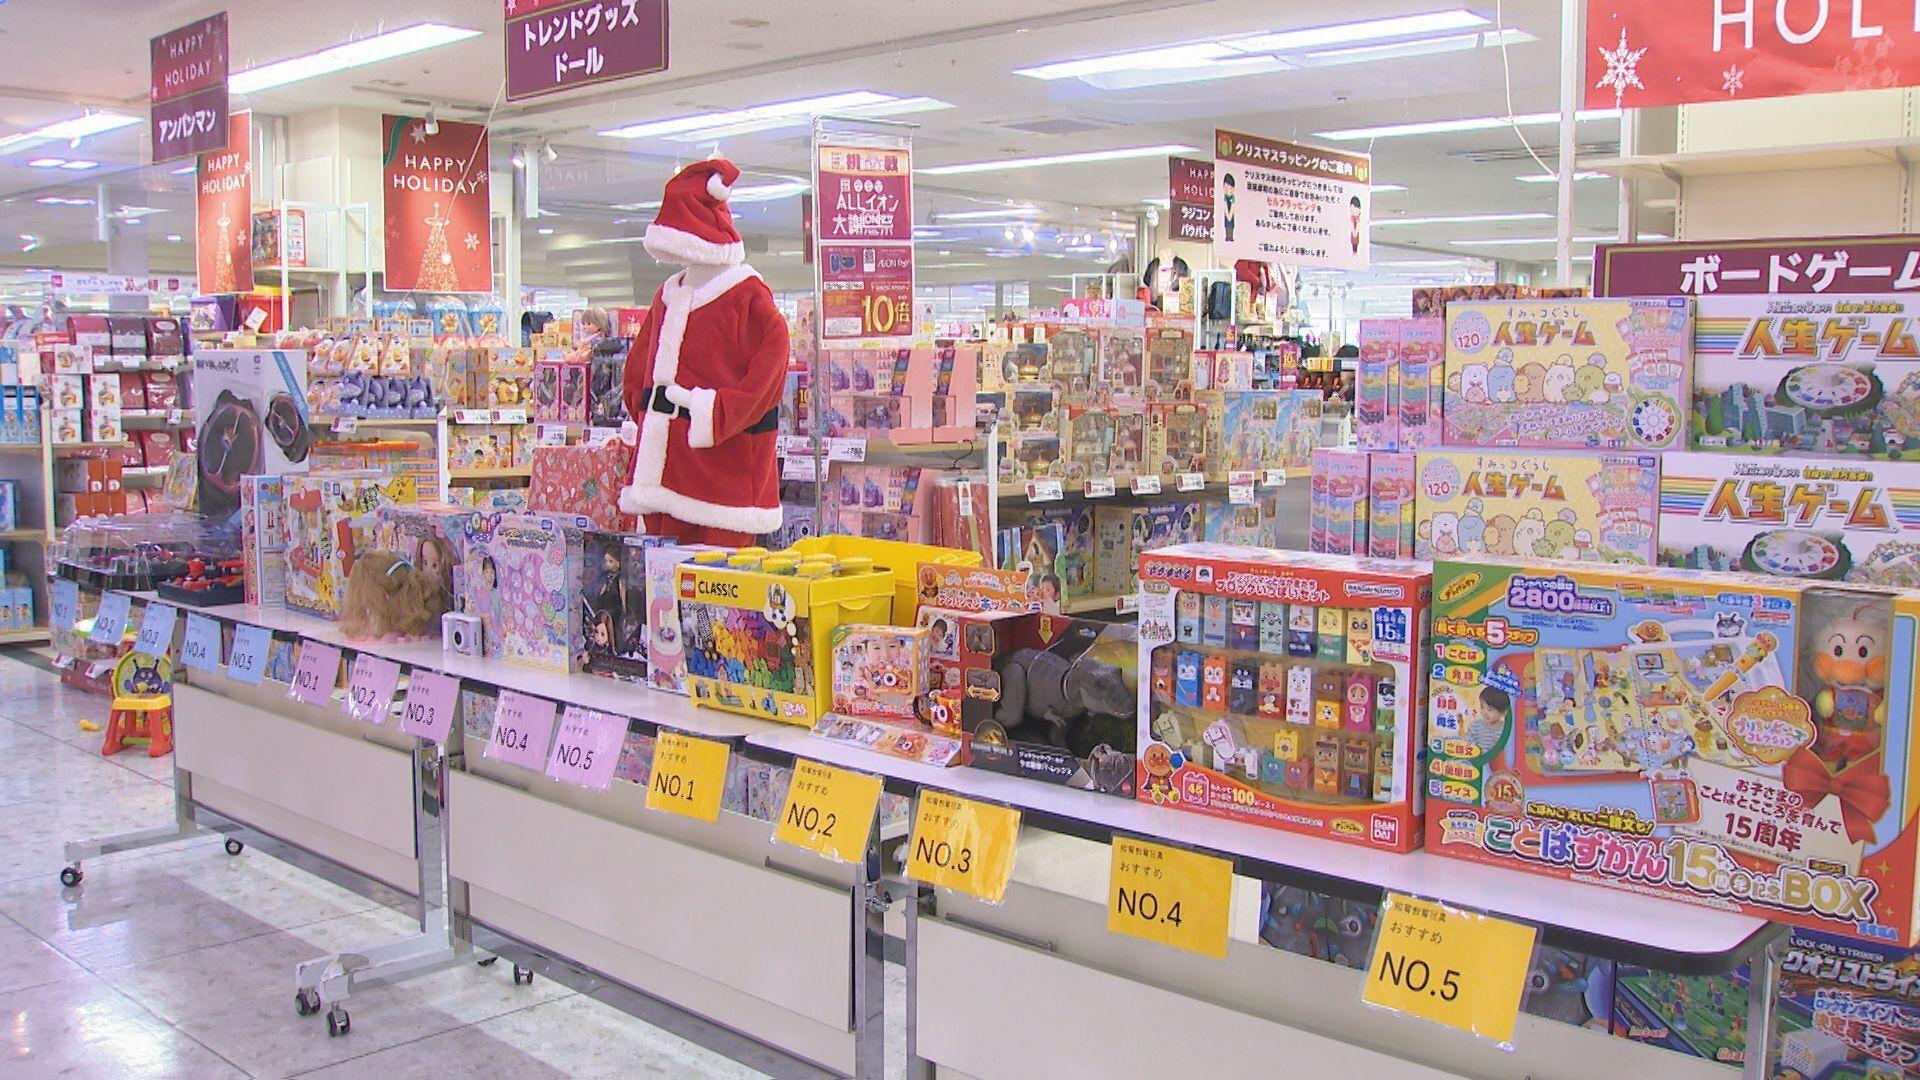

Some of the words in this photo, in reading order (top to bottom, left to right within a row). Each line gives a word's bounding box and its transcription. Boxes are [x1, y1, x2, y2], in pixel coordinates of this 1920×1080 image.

[525, 0, 639, 51] トレンドグッズ
[170, 34, 204, 59] HAPPY
[165, 60, 211, 87] HOLIDAY
[556, 46, 604, 82] ドール
[159, 109, 216, 143] アンパンマン
[207, 153, 240, 172] HAPPY
[405, 154, 467, 173] HAPPY
[1235, 142, 1352, 176] クリスマスラッピングのご案内
[202, 173, 246, 194] HOLIDAY
[394, 174, 478, 194] HOLIDAY
[1181, 206, 1211, 221] ラジコン
[861, 294, 911, 333] 10倍
[1507, 306, 1581, 319] すみっコぐらし
[1491, 320, 1598, 347] 人生ゲーム
[1738, 316, 1920, 359] 人生ゲーム
[1476, 457, 1554, 471] すみっコぐらし
[1461, 471, 1567, 501] 人生ゲーム
[1707, 479, 1892, 529] 人生ゲーム
[698, 580, 739, 598] CLASSIC
[185, 639, 206, 659] NO.4
[233, 651, 254, 671] NO.5
[298, 669, 319, 692] NO.1
[351, 684, 377, 708] NO.2
[406, 701, 435, 726] NO.3
[495, 726, 528, 751] NO.4
[556, 744, 594, 770] NO.5
[655, 771, 694, 801] NO.1
[797, 780, 829, 797] おすすめ
[1736, 779, 1802, 807] お子さまの
[787, 803, 836, 838] NO.2
[1725, 813, 1803, 852] 15周年
[916, 837, 972, 873] NO.3
[1120, 861, 1163, 880] おすすめ
[1117, 887, 1183, 928] NO.4
[1390, 922, 1442, 944] おすすめ
[1379, 951, 1461, 1002] NO.5
